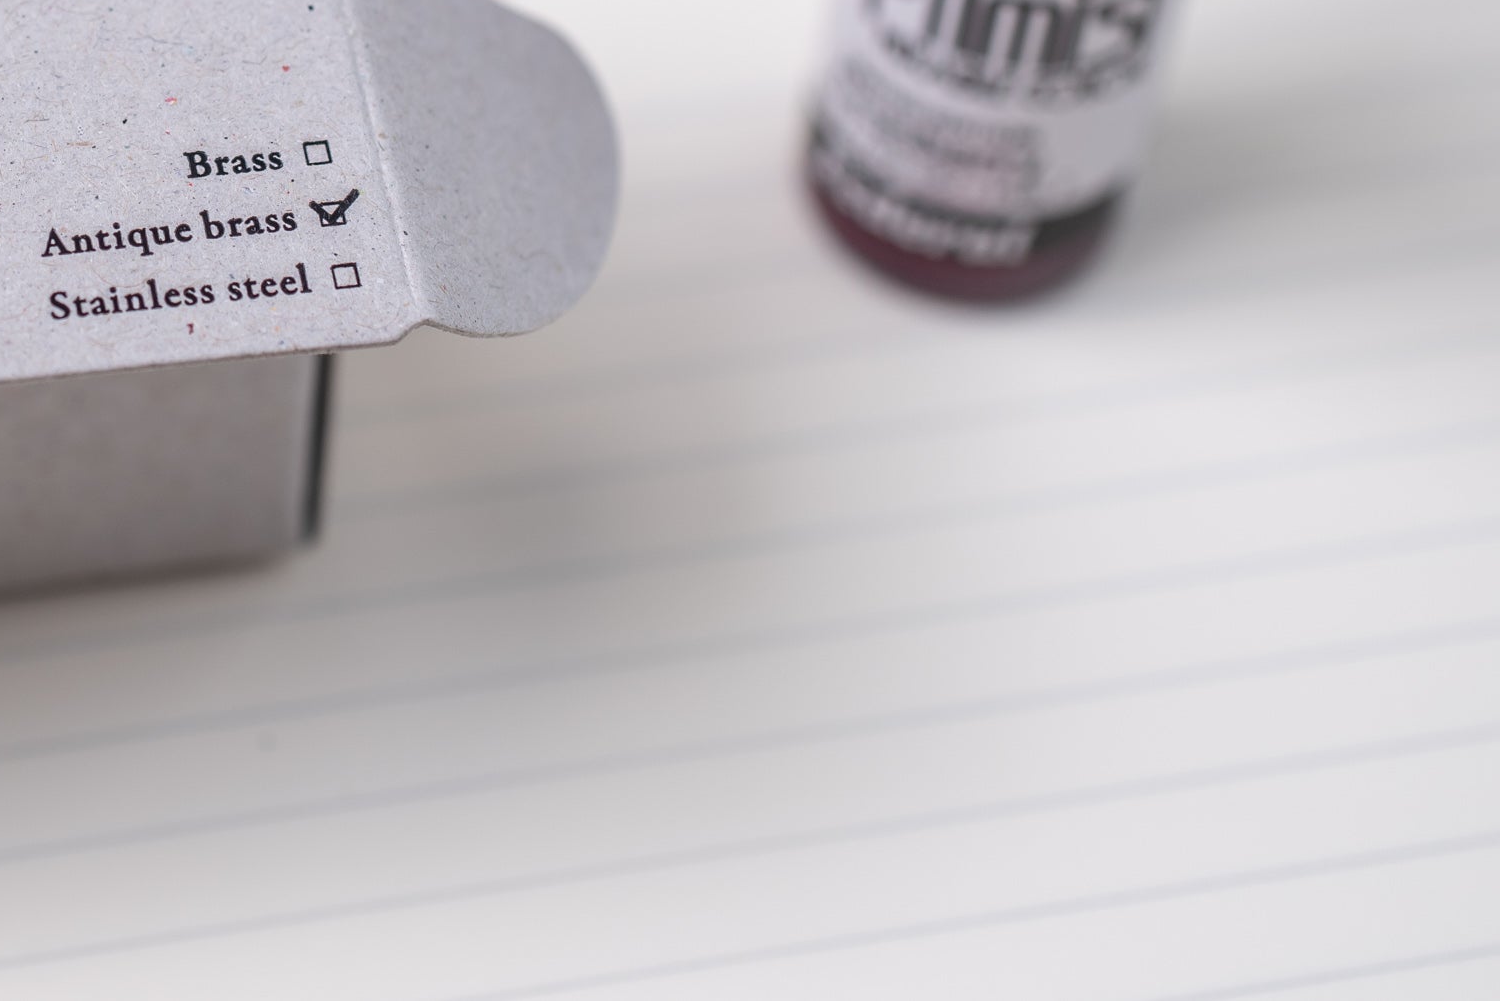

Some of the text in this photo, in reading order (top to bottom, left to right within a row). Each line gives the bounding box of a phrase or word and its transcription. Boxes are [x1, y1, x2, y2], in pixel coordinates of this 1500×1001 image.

[182, 149, 285, 180] Brass
[40, 208, 299, 259] Antique brass
[49, 261, 314, 321] Stainless steel
